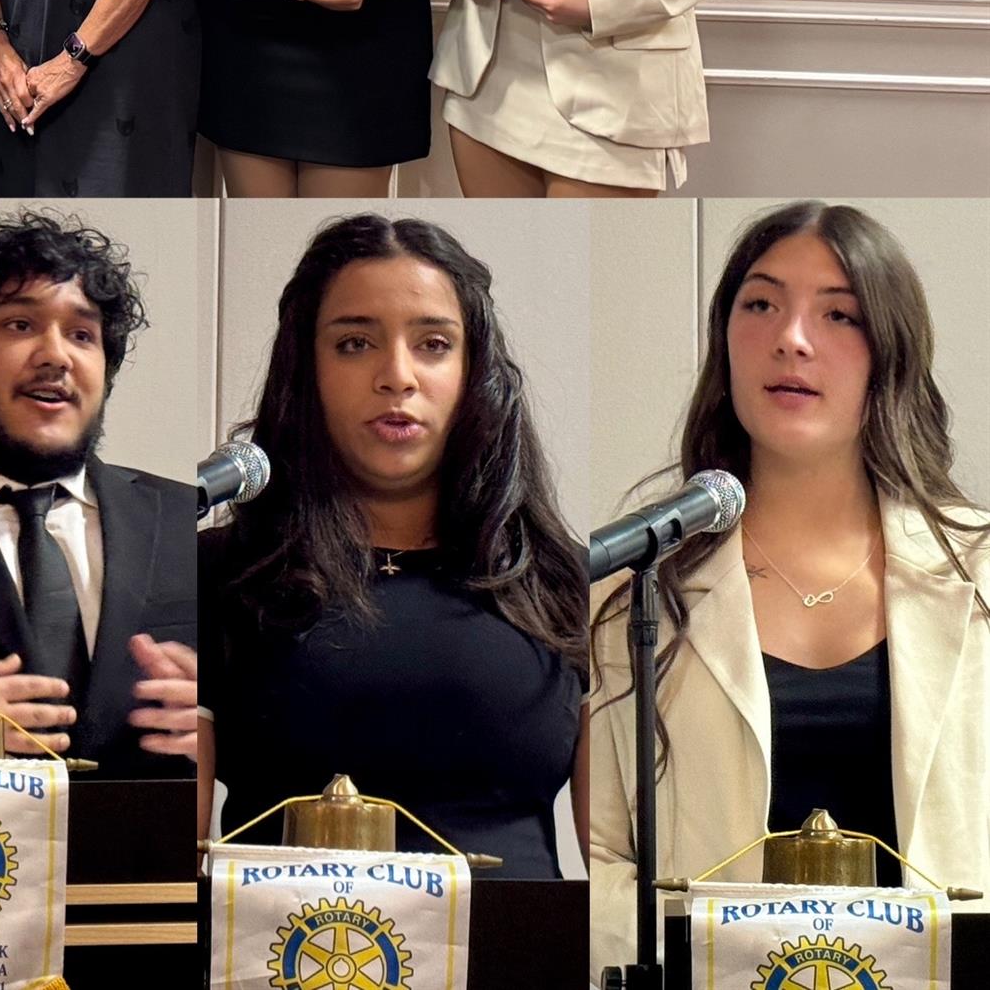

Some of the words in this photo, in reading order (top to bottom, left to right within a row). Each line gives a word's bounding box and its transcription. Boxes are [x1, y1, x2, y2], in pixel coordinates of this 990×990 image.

[241, 863, 358, 887] ROTARY
[367, 863, 444, 898] CLUB
[333, 880, 354, 894] OF
[314, 912, 371, 929] ROTARY
[721, 900, 837, 925] ROTARY
[846, 900, 925, 933] CLUB
[813, 918, 834, 931] OF
[794, 950, 851, 967] ROTARY
